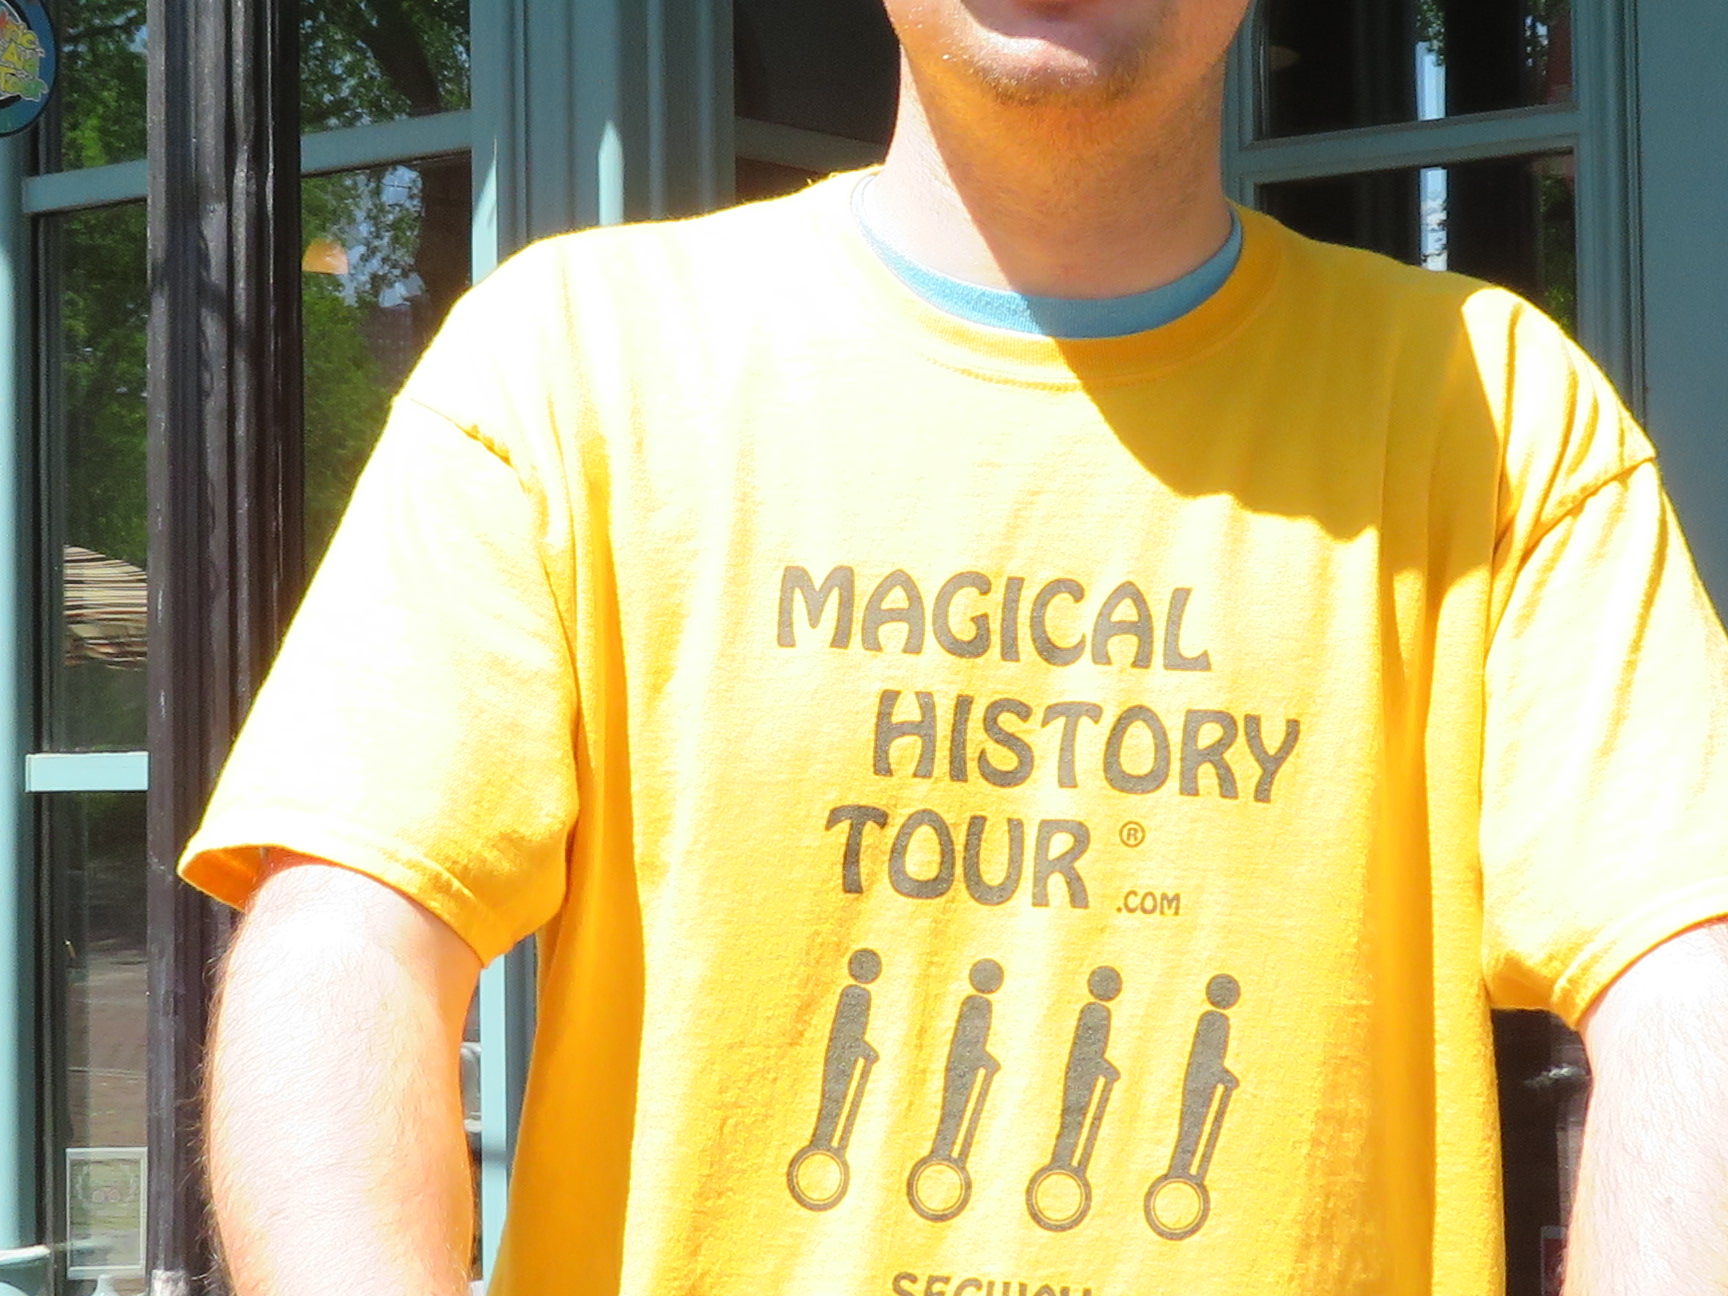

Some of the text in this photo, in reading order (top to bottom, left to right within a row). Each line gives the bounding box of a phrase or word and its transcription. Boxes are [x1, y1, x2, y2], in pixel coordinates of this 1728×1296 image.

[777, 565, 1211, 672] MAGICAL
[872, 689, 1301, 805] HISTORY
[825, 804, 1090, 910] TOUR
